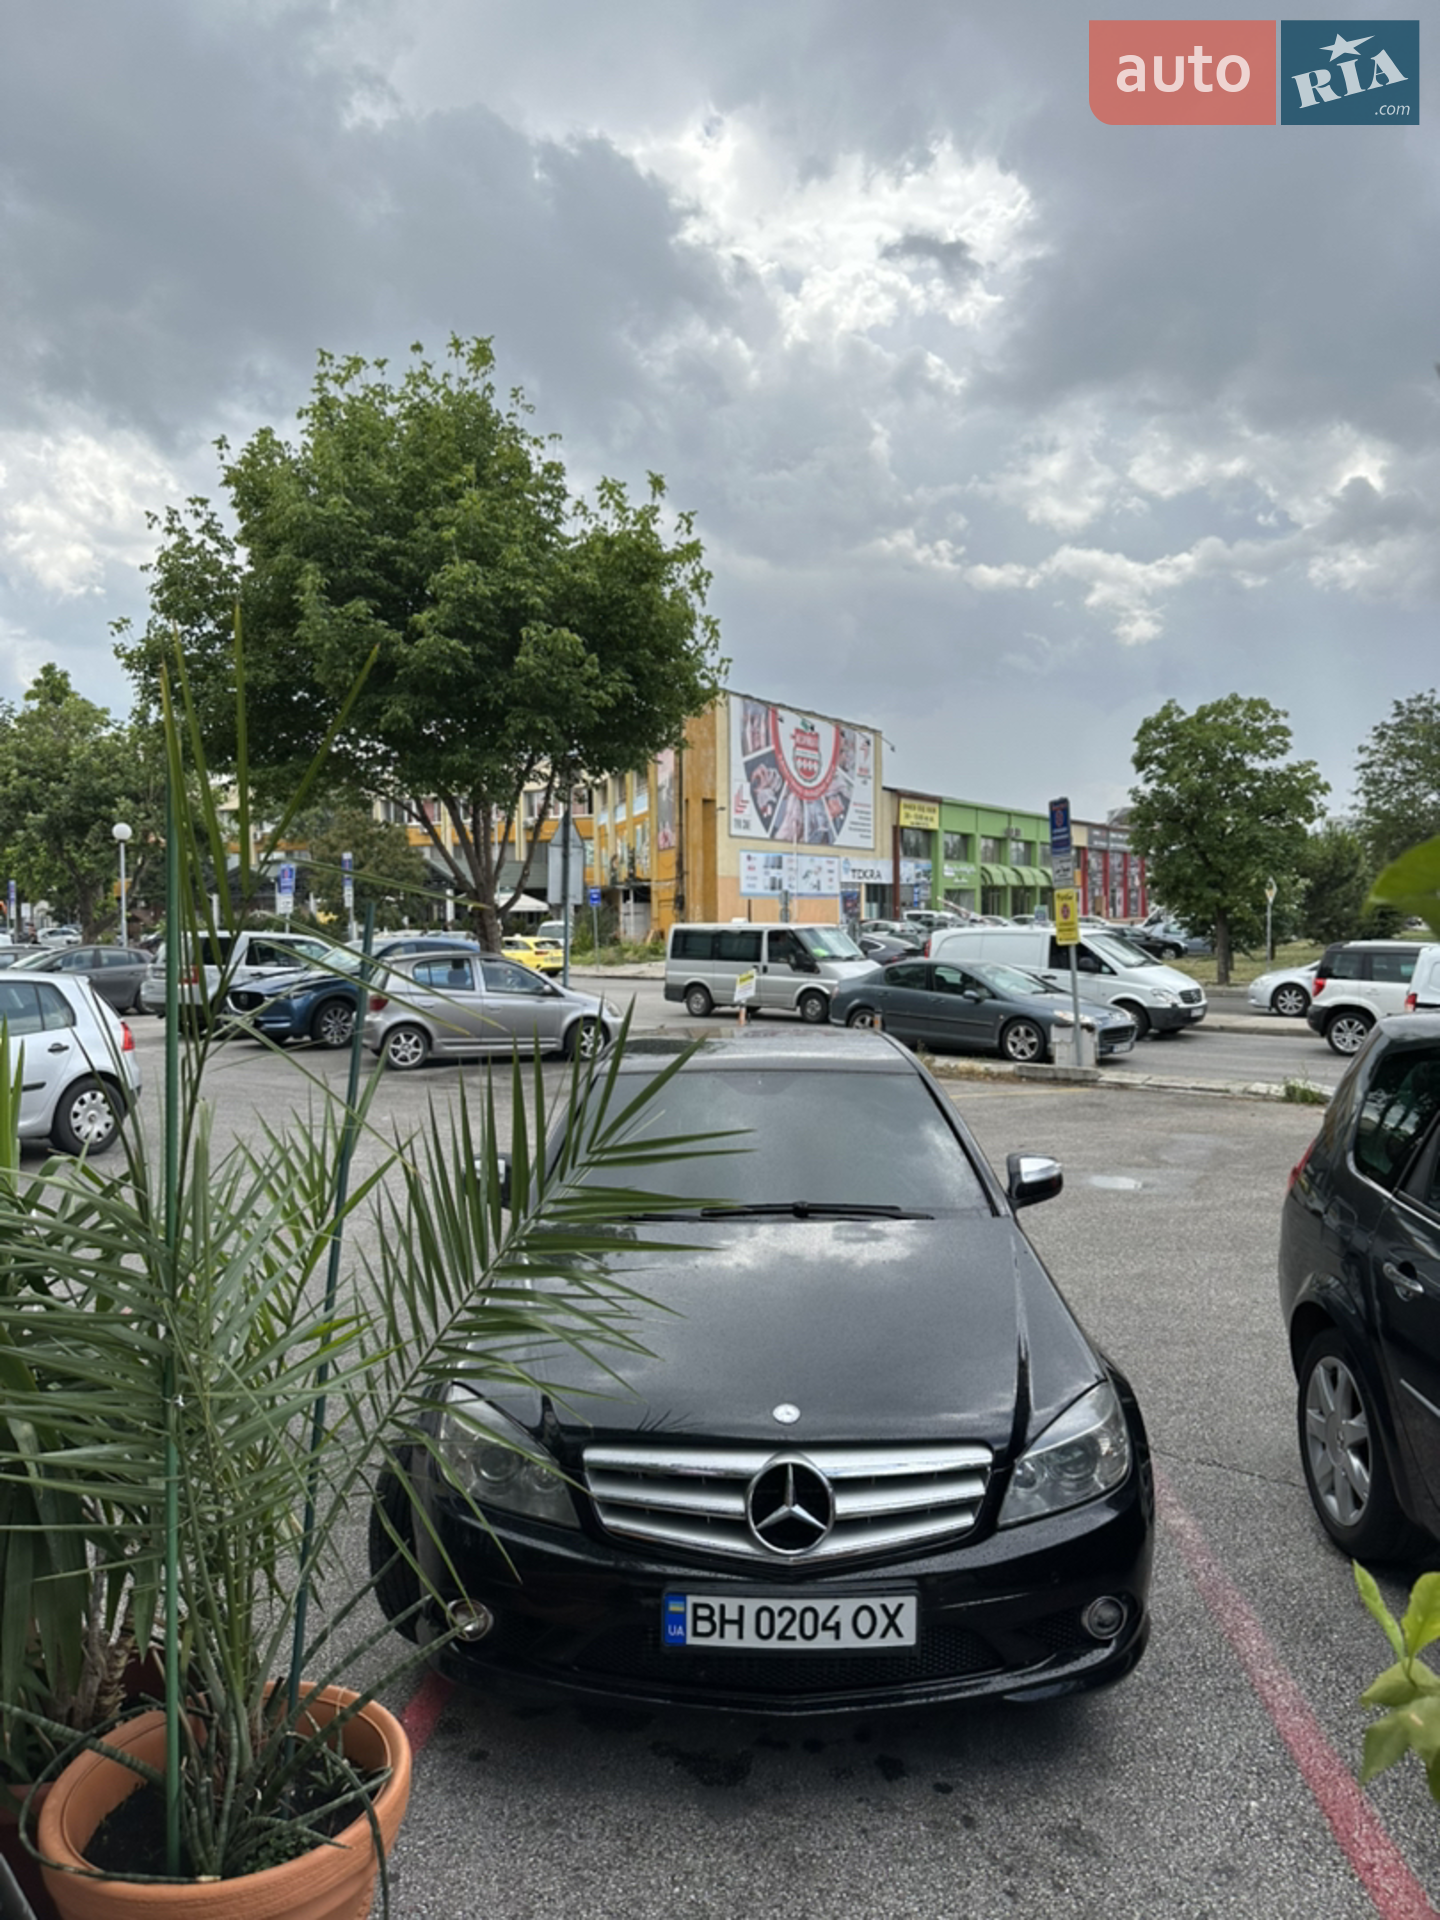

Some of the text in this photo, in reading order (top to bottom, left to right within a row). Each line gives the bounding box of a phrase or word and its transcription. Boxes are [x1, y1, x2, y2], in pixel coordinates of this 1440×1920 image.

[668, 1625, 685, 1636] UA
[691, 1603, 905, 1641] BH 0204 OX
